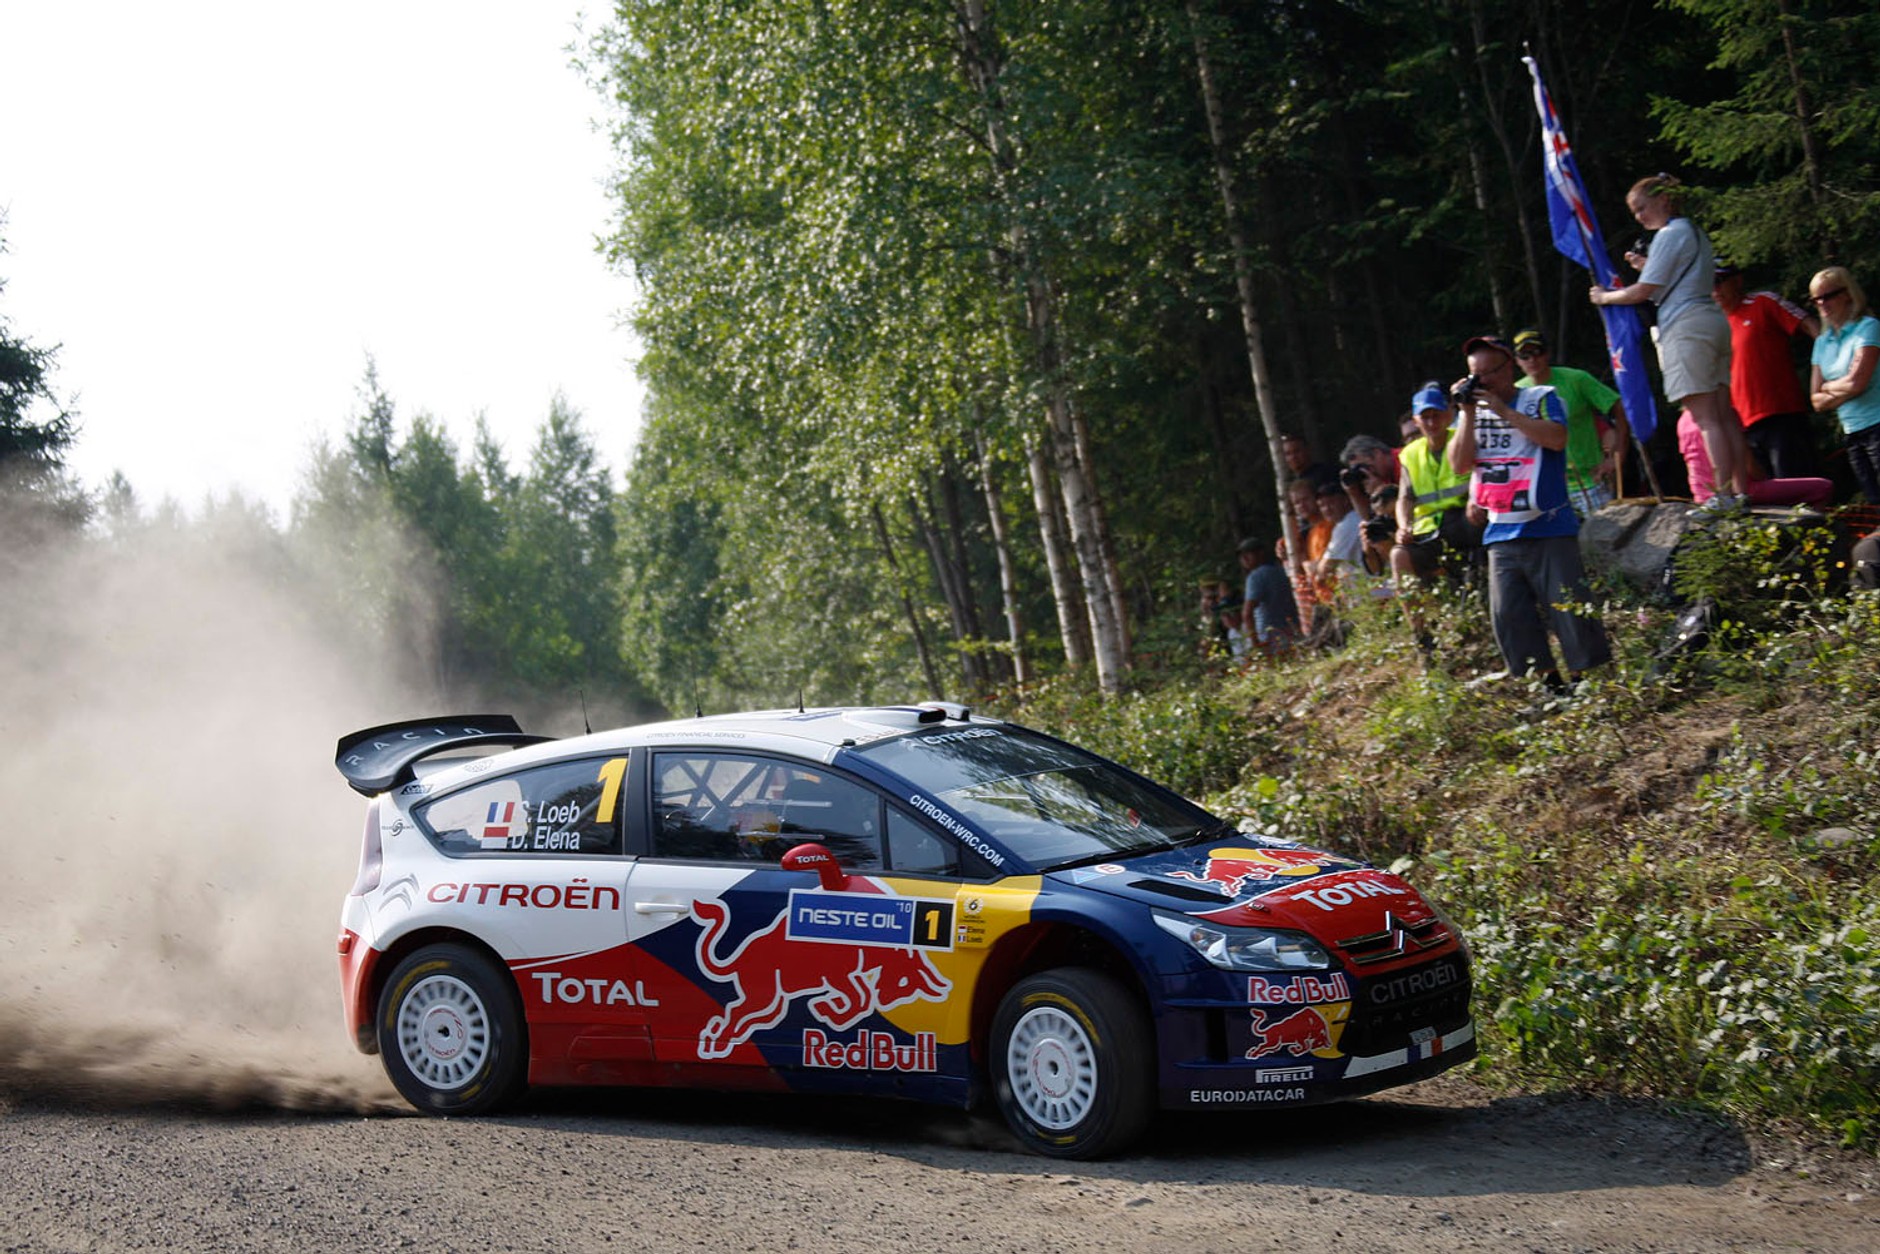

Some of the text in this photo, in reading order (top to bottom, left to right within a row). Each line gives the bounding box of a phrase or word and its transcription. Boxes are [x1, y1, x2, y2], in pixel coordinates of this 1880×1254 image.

[596, 758, 628, 823] 1
[537, 801, 580, 823] Loeb
[534, 826, 580, 850] Elena
[910, 794, 1004, 868] CITROEN-WRC.COM
[795, 855, 829, 864] TOTAL
[1290, 879, 1405, 912] TOTAL
[799, 908, 868, 928] NESTE
[872, 914, 902, 930] OIL
[924, 910, 940, 940] 1
[532, 972, 659, 1007] TOTAL
[1247, 972, 1350, 1004] Red Bull
[803, 1029, 937, 1072] Red Bull
[1256, 1066, 1313, 1083] PIRELLI
[1190, 1088, 1305, 1103] EURODATACAR
